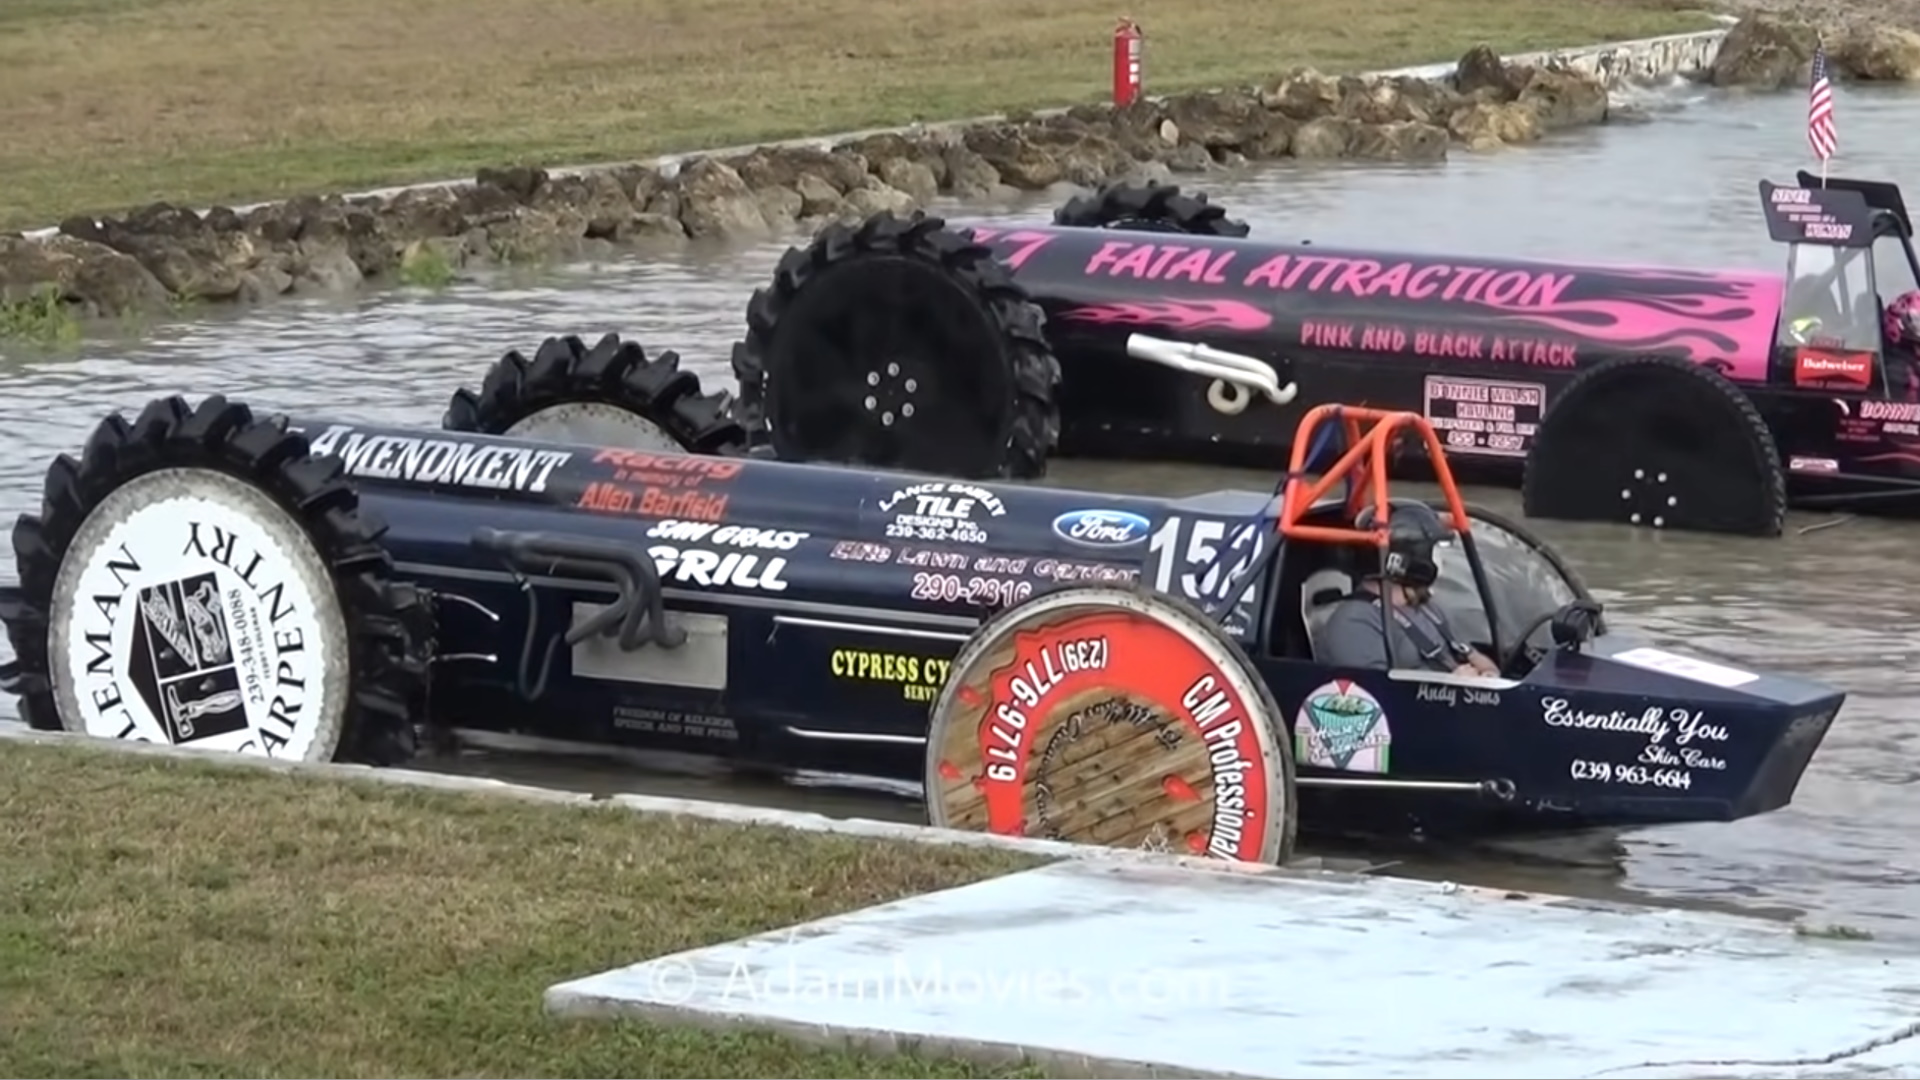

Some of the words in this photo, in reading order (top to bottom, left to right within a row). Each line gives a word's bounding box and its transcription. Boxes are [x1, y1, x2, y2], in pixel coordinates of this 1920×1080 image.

[1085, 241, 1236, 284] FATAL
[1243, 254, 1576, 307] ATTRACTION
[1301, 322, 1353, 348] PINK
[1361, 326, 1406, 351] AND
[1414, 330, 1484, 358] BLACK
[1490, 338, 1577, 367] ATTACK
[1803, 358, 1866, 371] Budweiser
[309, 424, 573, 493] AMENDMENT
[592, 447, 744, 480] Racing
[628, 471, 680, 488] memory
[684, 473, 705, 487] of
[578, 482, 634, 513] Allen
[638, 486, 729, 520] Barfield
[879, 483, 945, 512] LANCE
[916, 495, 976, 518] TILE
[647, 519, 720, 543] SAW
[885, 524, 988, 543] 239-362-4650
[896, 514, 954, 529] DESIGNS
[1070, 512, 1133, 542] Ford
[647, 546, 788, 591] GRILL
[896, 547, 968, 570] Lawn
[973, 552, 1027, 575] and
[1149, 516, 1264, 604] 152
[228, 588, 265, 704] 239-348-0088
[1058, 637, 1108, 673] (239)
[831, 649, 919, 683] CYPRESS
[1183, 675, 1232, 728] CM
[1416, 684, 1457, 707] Andy
[1463, 687, 1501, 706] Sims
[1541, 696, 1670, 743] Essentially
[1669, 708, 1728, 744] You
[1571, 759, 1611, 782] (239)
[1615, 764, 1692, 789] 963-6614
[1638, 745, 1681, 766] Skin
[1680, 748, 1728, 770] Care
[1203, 718, 1254, 864] Professional
